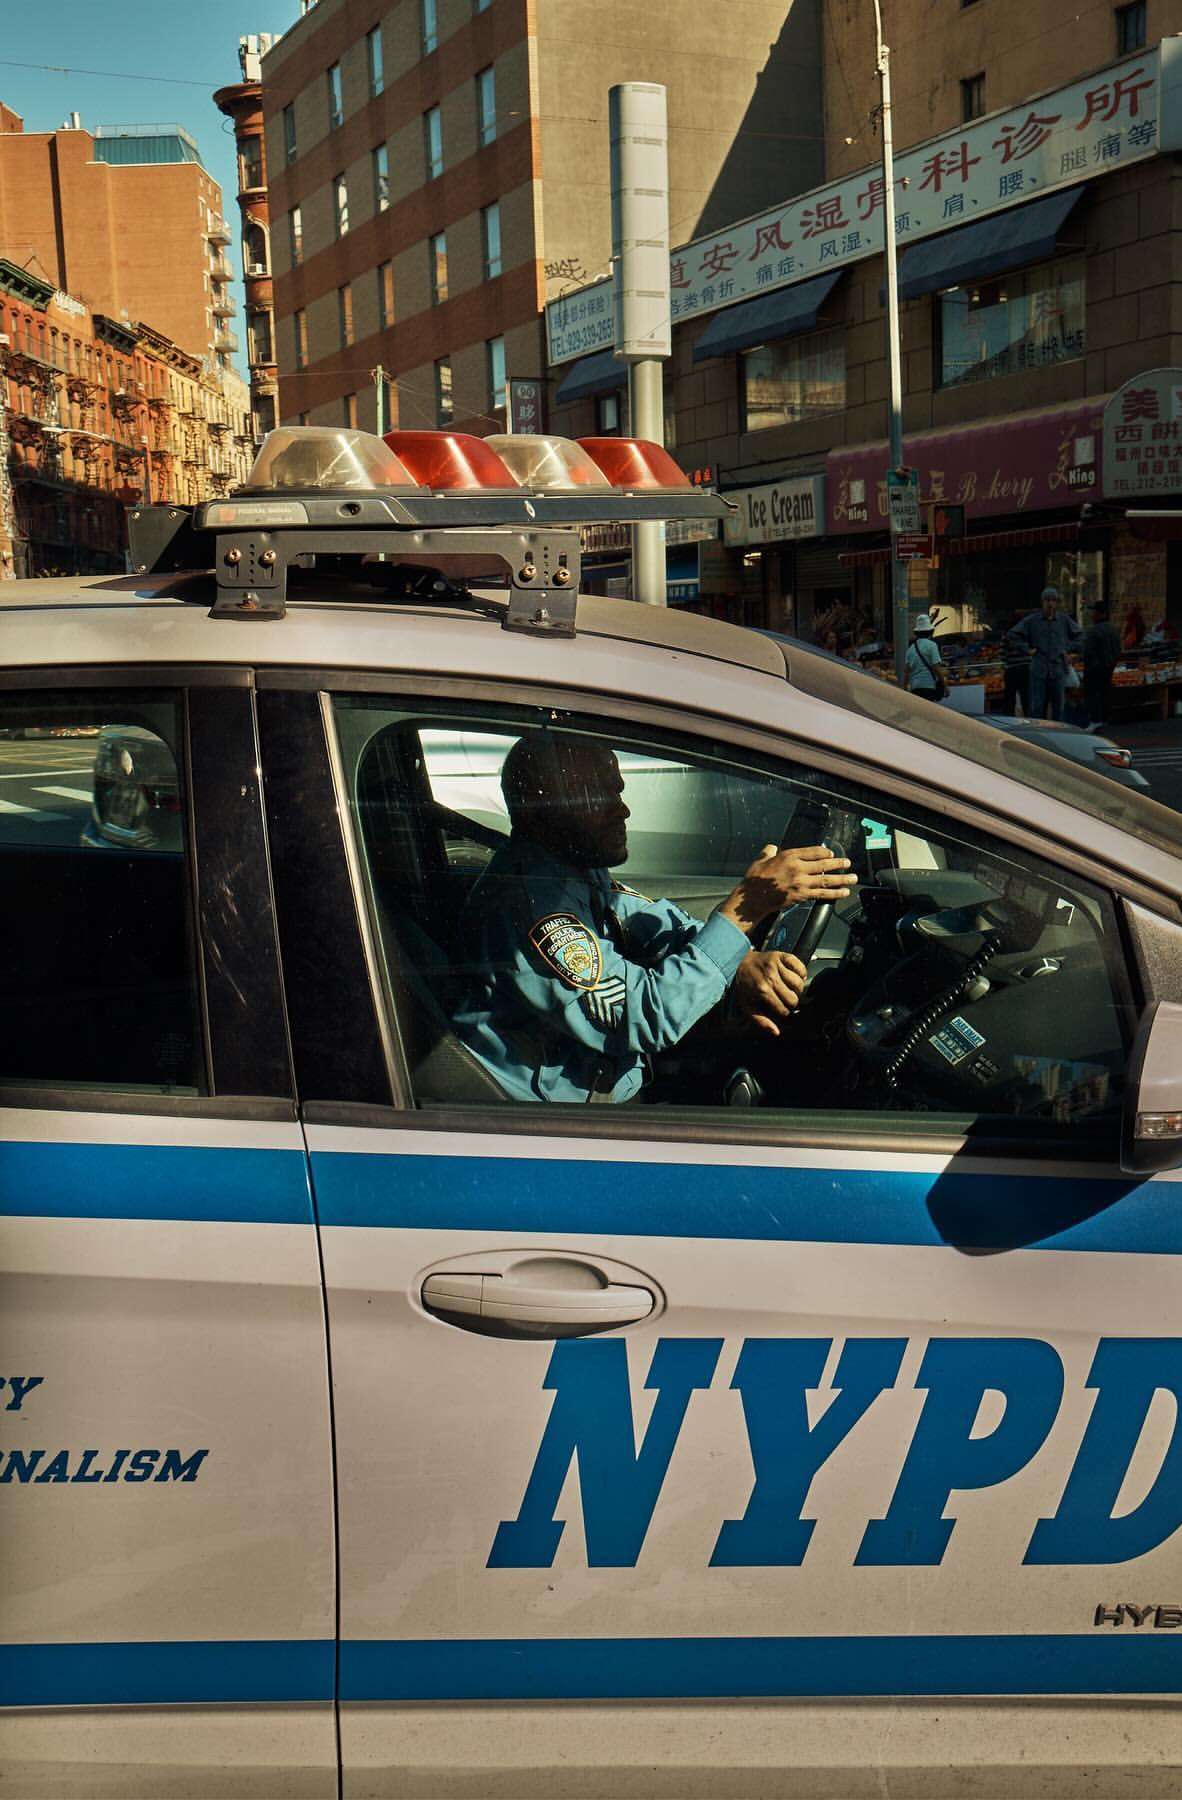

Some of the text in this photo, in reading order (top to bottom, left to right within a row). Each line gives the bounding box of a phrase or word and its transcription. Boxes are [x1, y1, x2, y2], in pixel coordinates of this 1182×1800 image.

[1069, 469, 1097, 486] King
[747, 489, 814, 528] Ice Cream
[0, 1449, 210, 1484] NALISM
[485, 1337, 1182, 1568] NYPD
